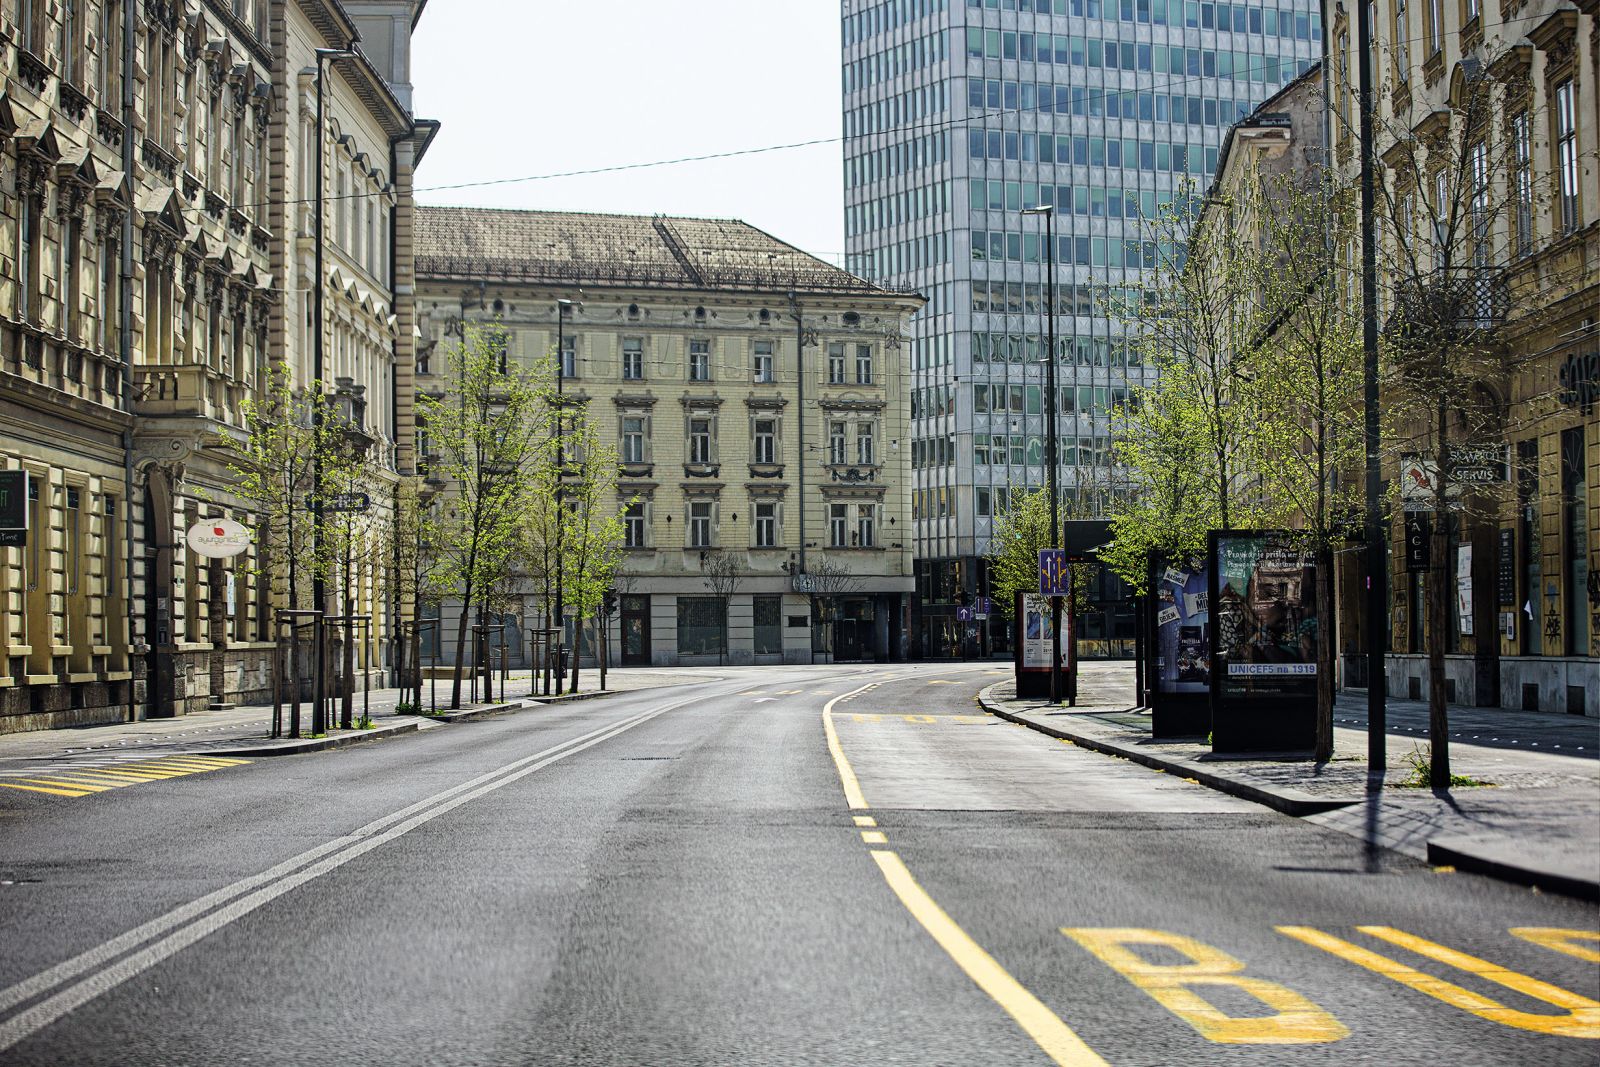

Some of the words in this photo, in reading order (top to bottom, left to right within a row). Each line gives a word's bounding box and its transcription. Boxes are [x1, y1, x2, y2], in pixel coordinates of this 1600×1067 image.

[1230, 665, 1274, 673] UNICEF5
[1293, 665, 1315, 673] 1919
[1060, 925, 1600, 1044] BU
